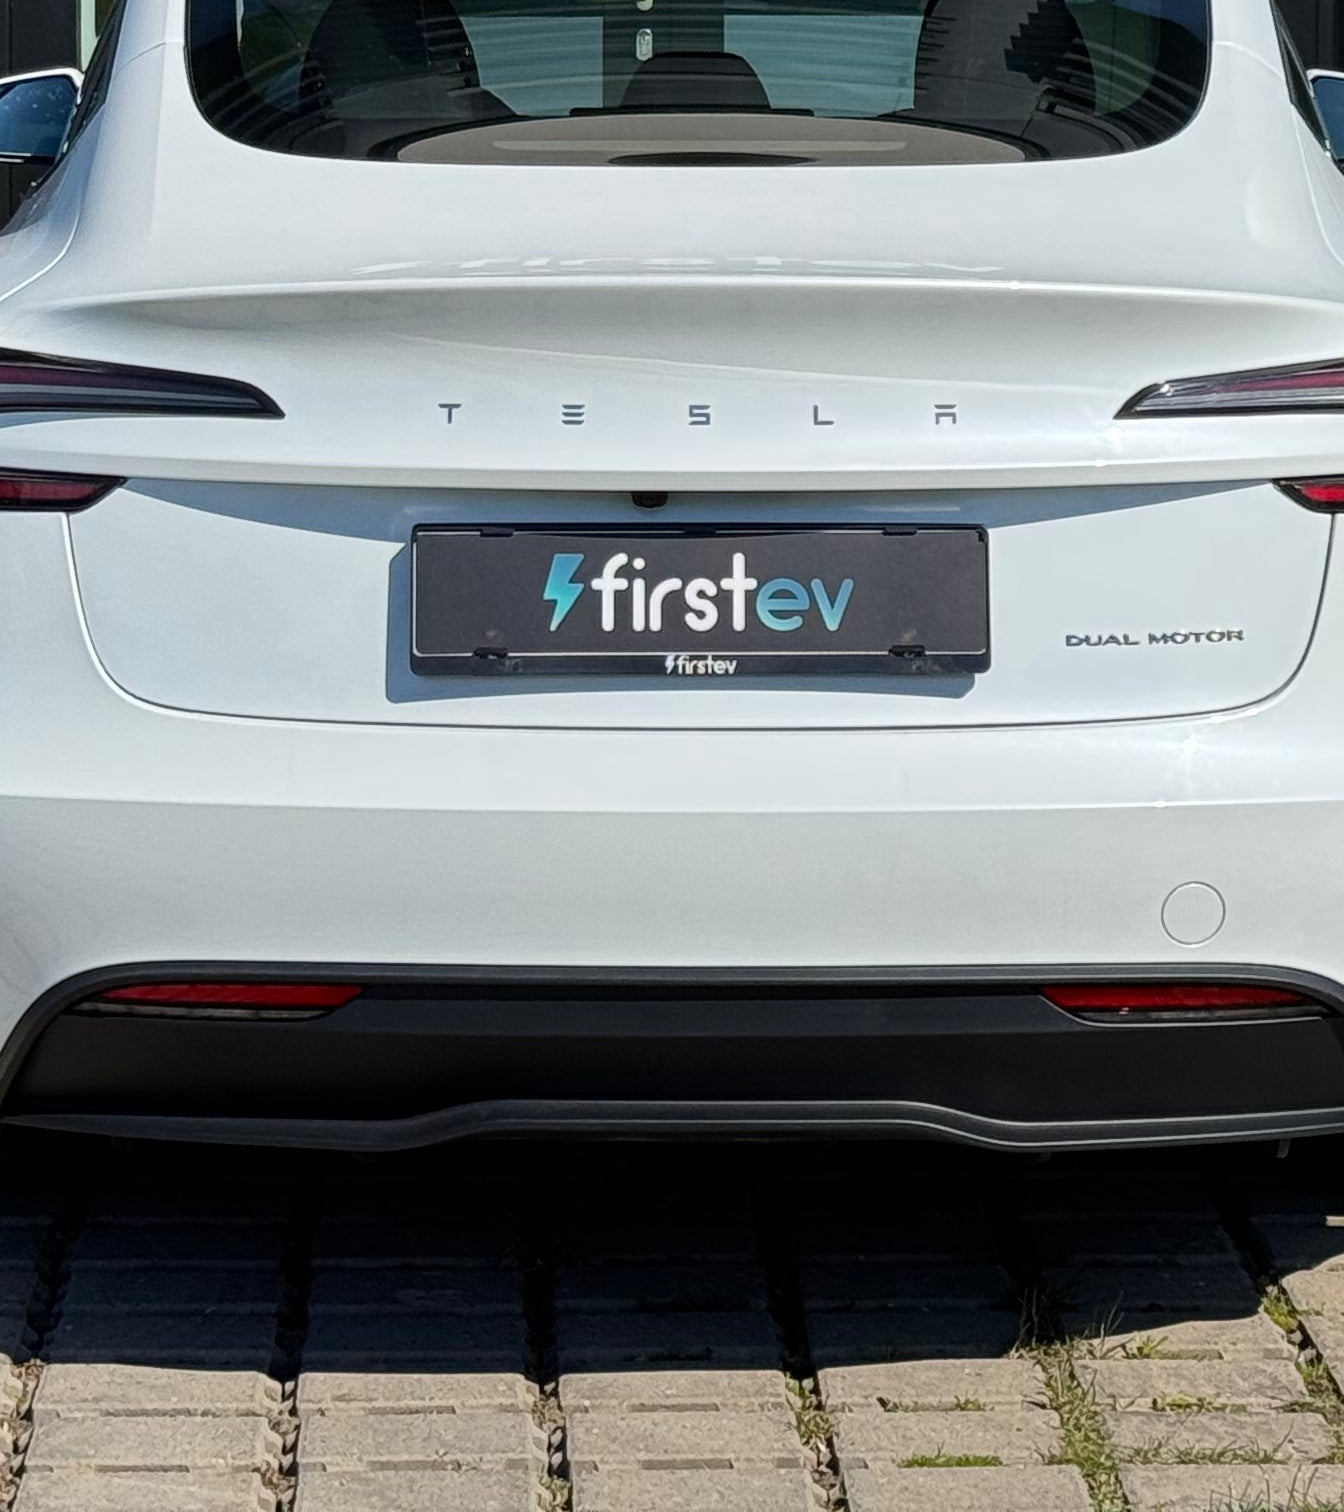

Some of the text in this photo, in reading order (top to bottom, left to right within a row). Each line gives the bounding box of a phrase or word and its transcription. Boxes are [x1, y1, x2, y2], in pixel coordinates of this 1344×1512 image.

[438, 403, 958, 426] TESLA
[590, 551, 855, 633] firstev
[1065, 630, 1245, 647] DUAL MOTOR
[676, 653, 738, 676] firstev
